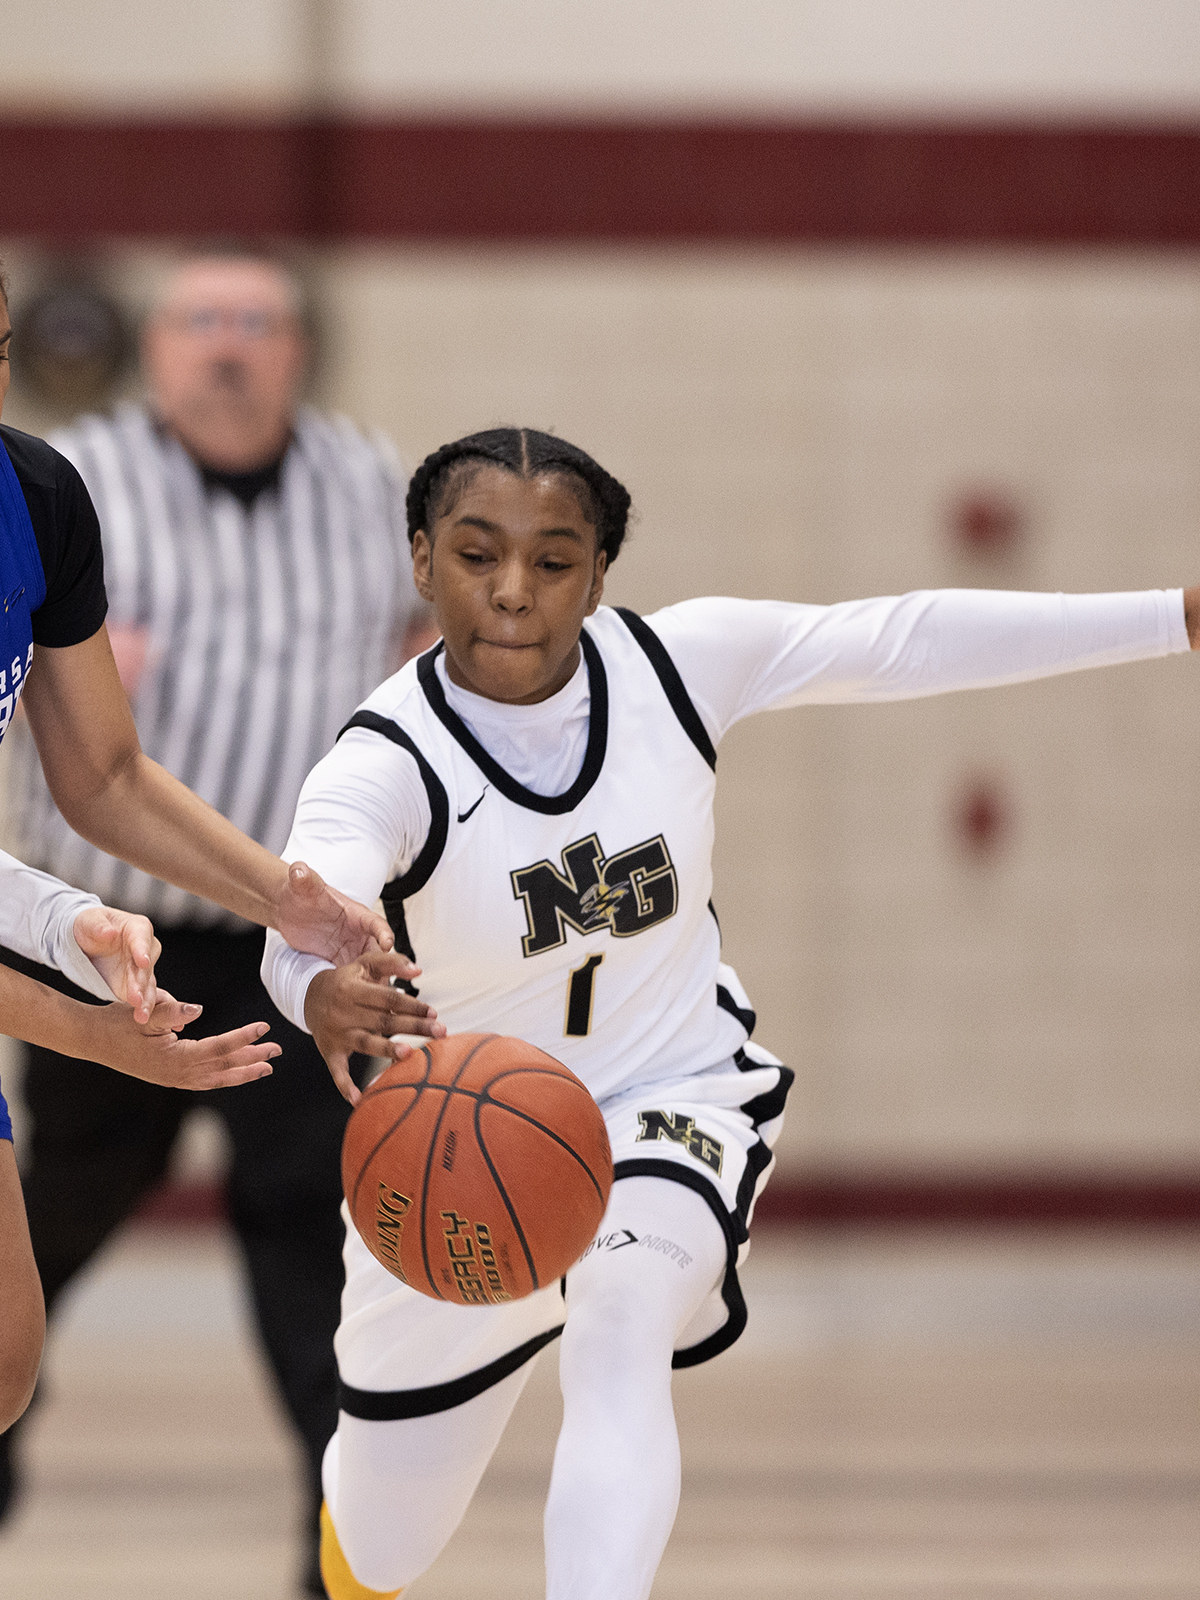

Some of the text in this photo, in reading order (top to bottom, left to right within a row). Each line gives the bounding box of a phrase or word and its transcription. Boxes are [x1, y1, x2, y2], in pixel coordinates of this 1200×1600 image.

[509, 832, 678, 958] NG
[563, 952, 605, 1038] 1
[635, 1109, 724, 1178] NG
[440, 1210, 494, 1305] EGACY
